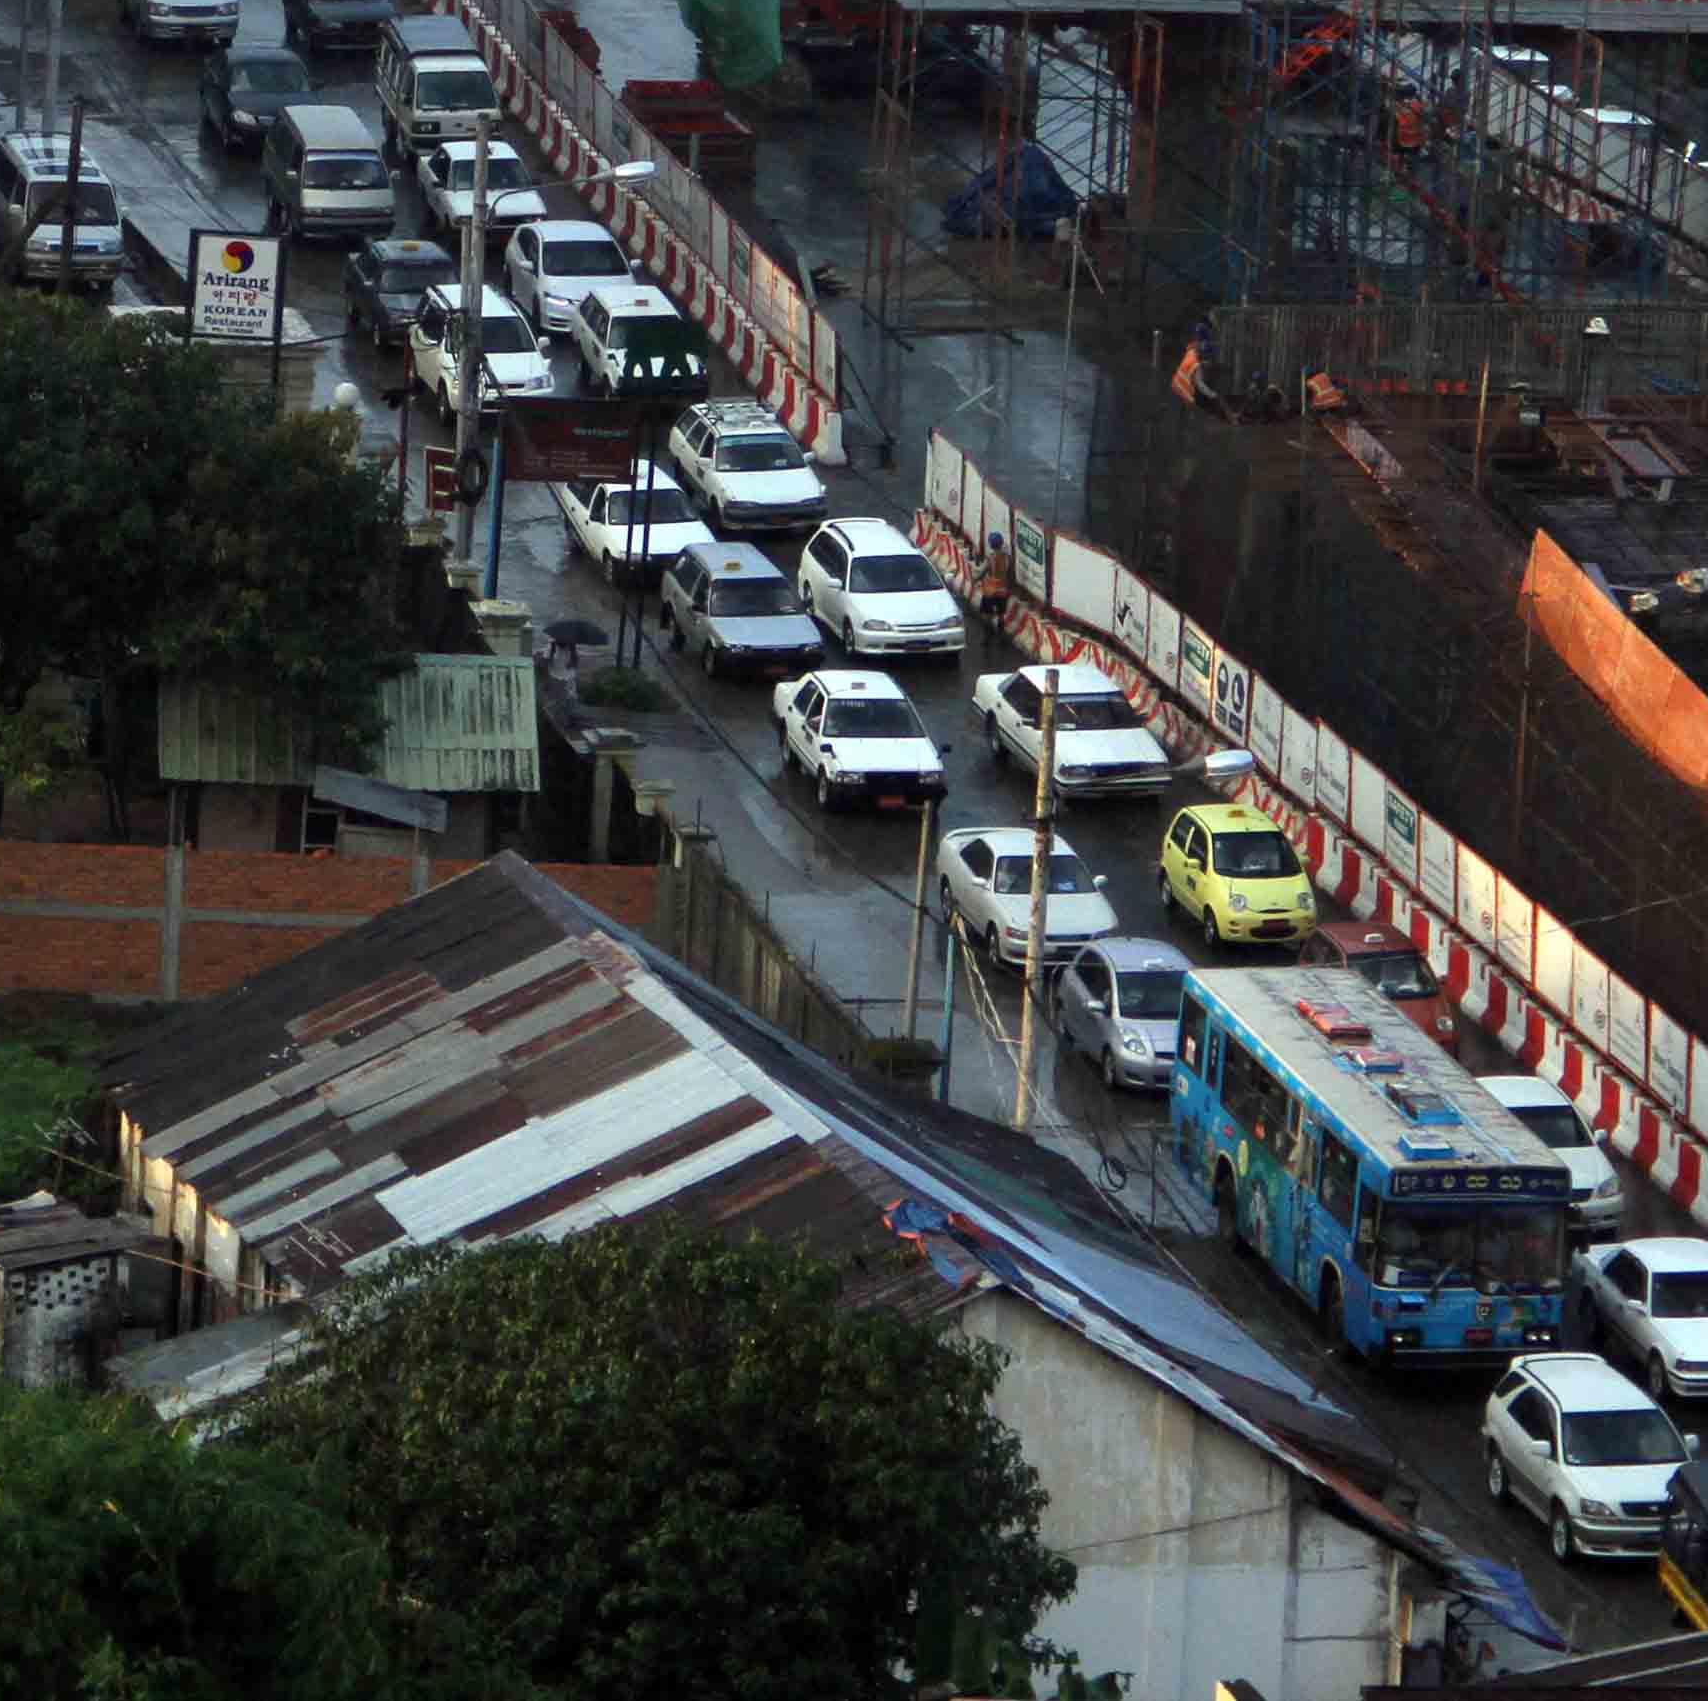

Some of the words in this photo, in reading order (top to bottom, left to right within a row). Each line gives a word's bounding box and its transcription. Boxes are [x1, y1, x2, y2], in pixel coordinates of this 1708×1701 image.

[203, 271, 269, 292] Arirang
[203, 304, 267, 318] KOREAN
[203, 316, 263, 329] Restaurant
